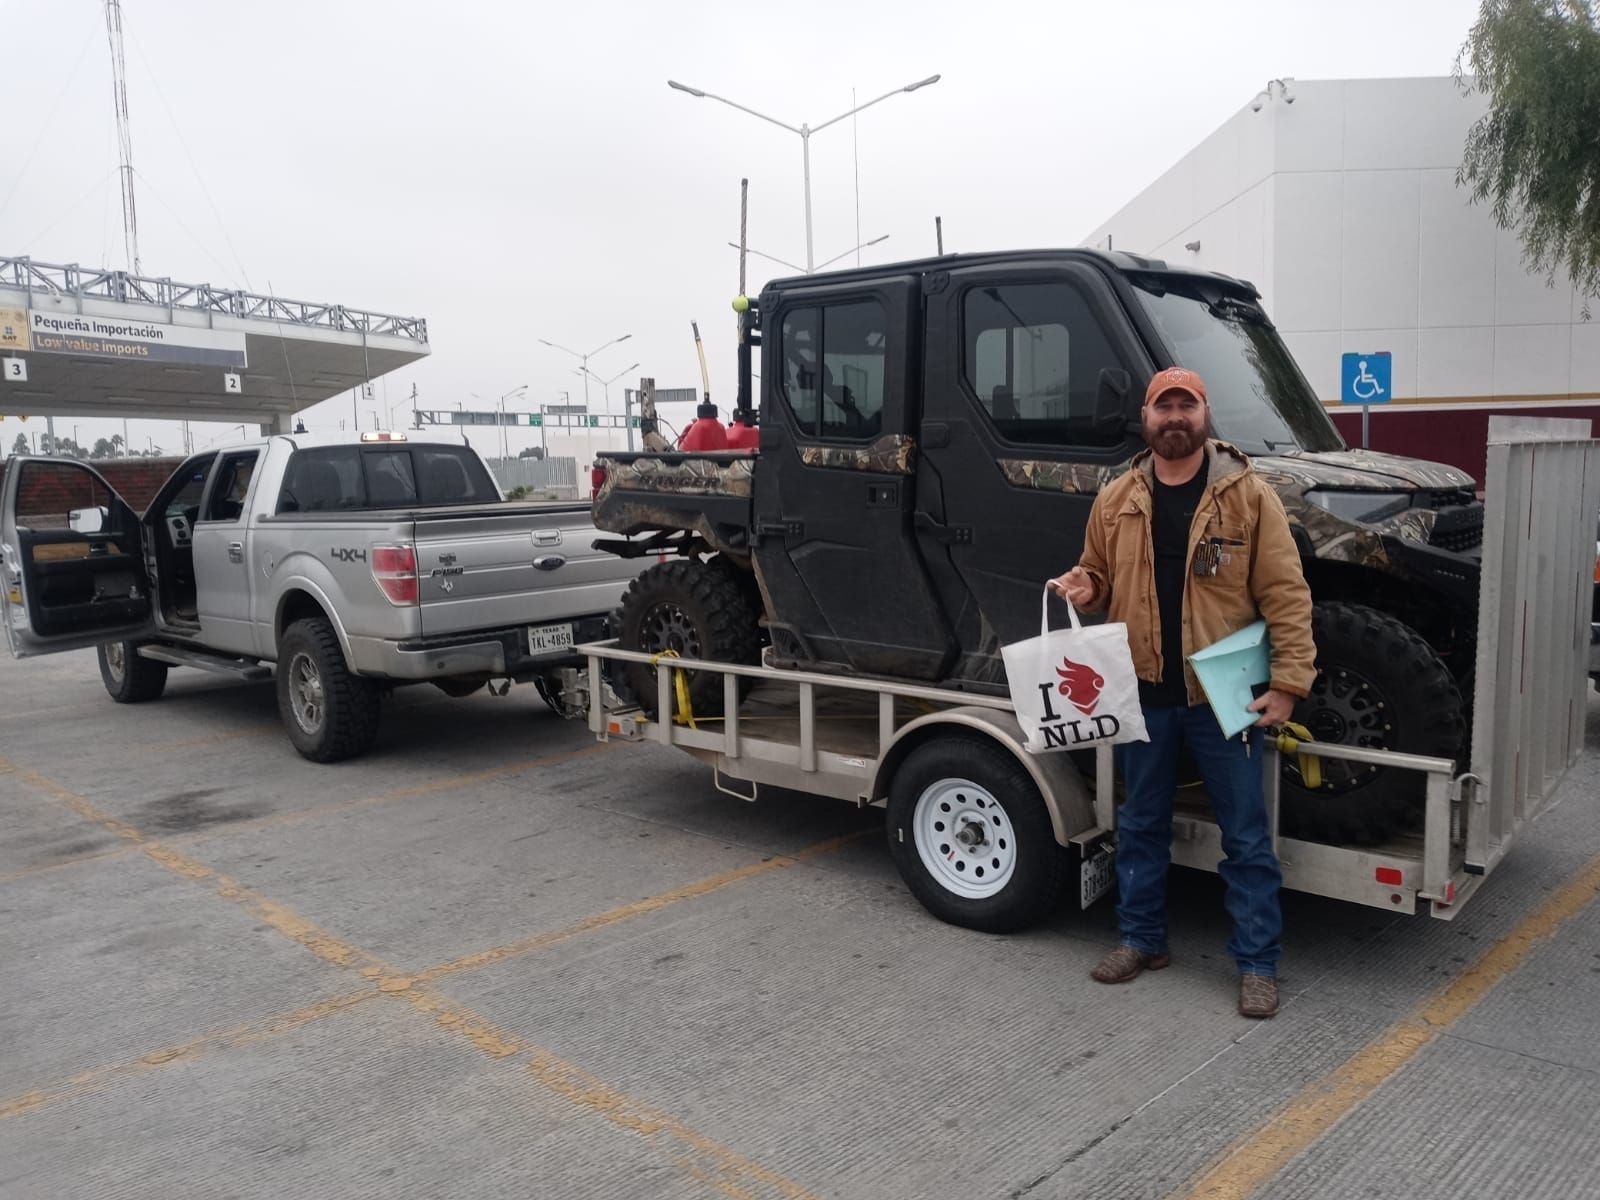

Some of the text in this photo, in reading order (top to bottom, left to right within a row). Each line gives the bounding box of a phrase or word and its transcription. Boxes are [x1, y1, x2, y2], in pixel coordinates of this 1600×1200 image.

[34, 315, 164, 339] Pequeña Importación
[37, 335, 148, 356] Low value imports
[12, 364, 21, 376] 3
[229, 378, 236, 388] 2
[367, 387, 373, 396] 1
[640, 475, 721, 489] RANGER
[1038, 682, 1062, 722] I
[1038, 714, 1120, 750] NLD
